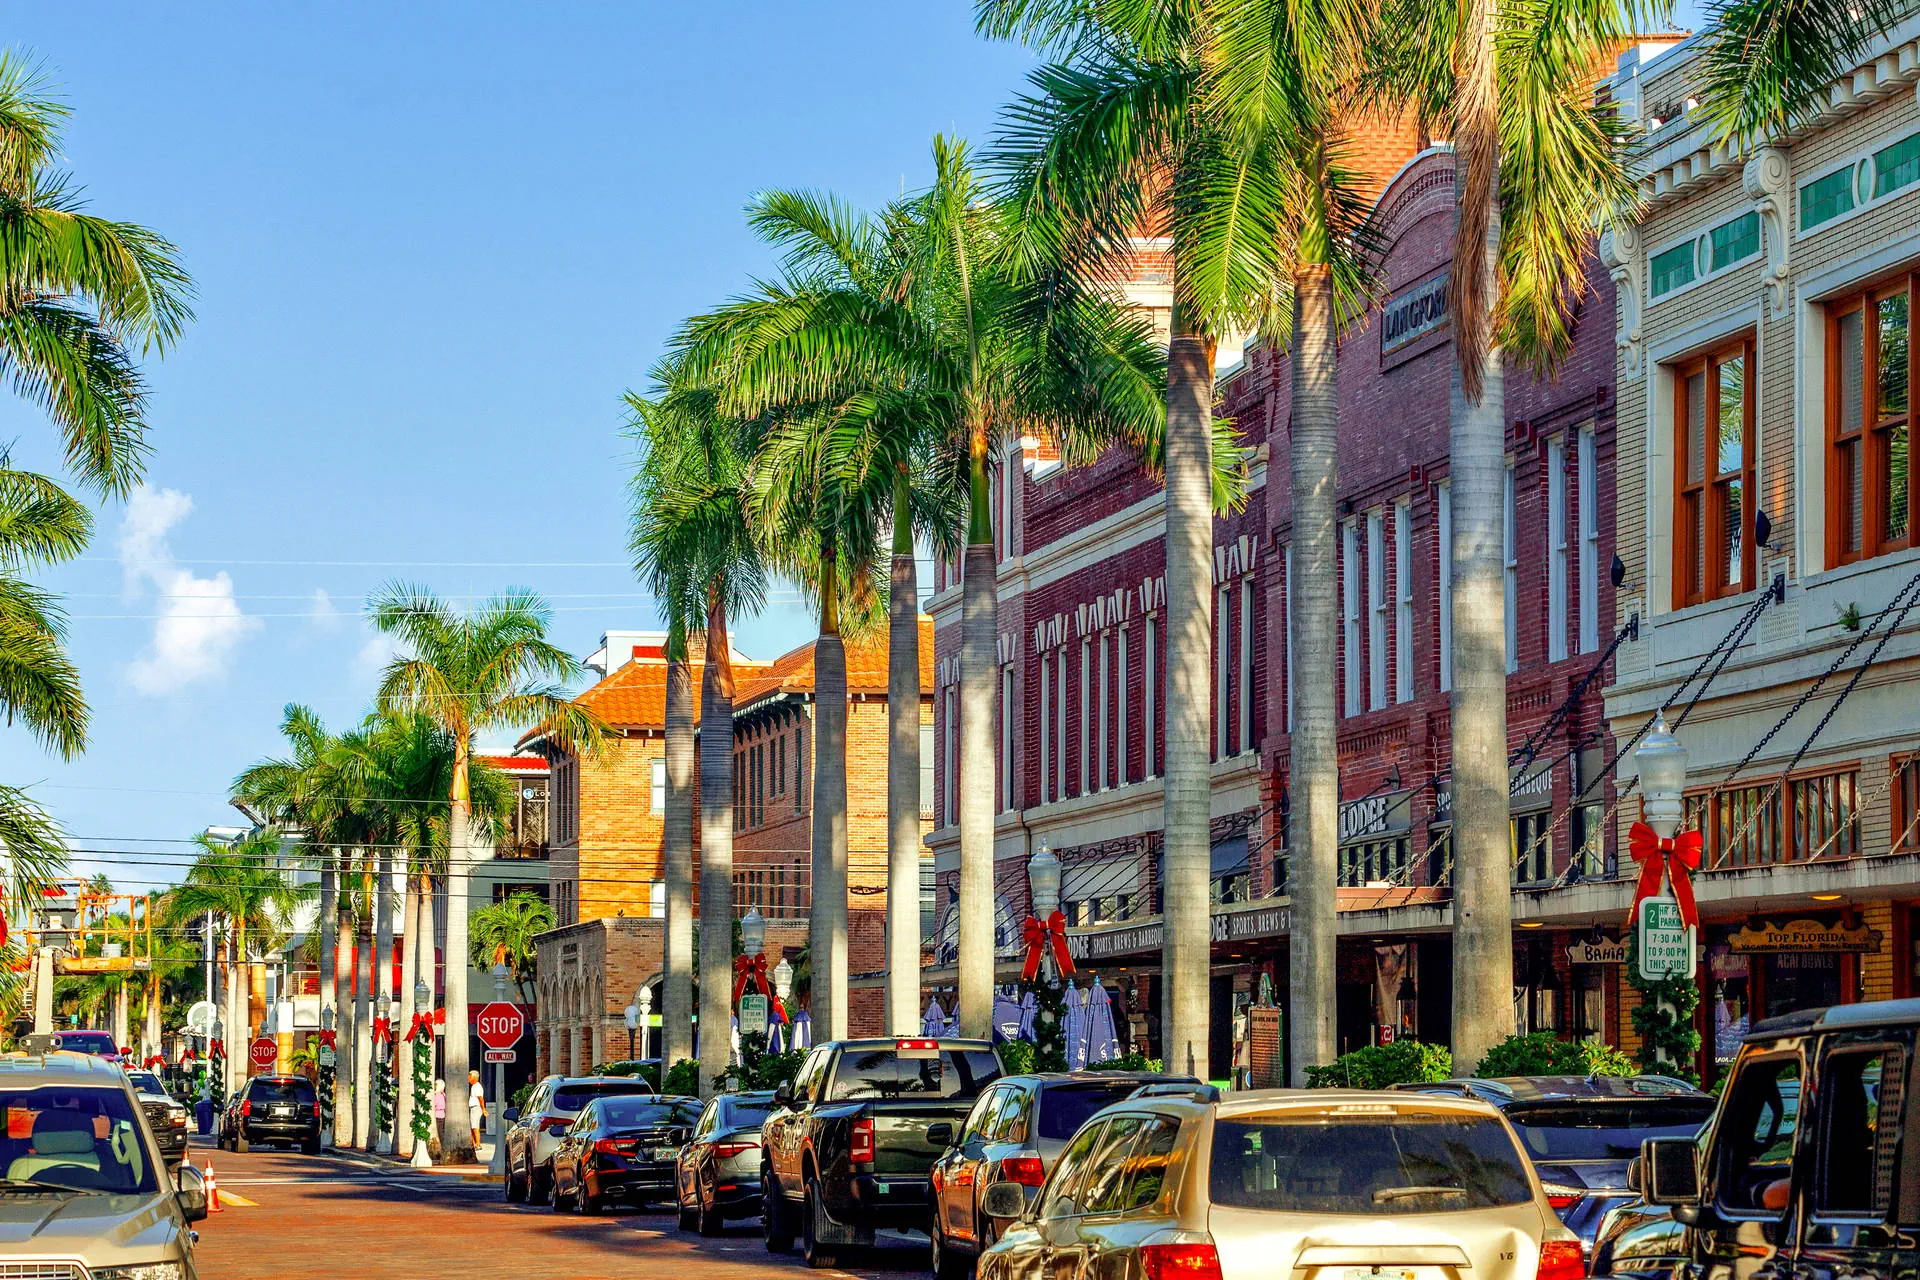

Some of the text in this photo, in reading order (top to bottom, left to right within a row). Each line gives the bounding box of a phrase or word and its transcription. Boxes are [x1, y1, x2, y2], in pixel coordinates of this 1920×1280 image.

[1340, 798, 1386, 838] LODGE
[1649, 909, 1656, 923] 2
[1233, 915, 1256, 936] SPORTS,
[1258, 911, 1279, 932] BREWS
[1281, 911, 1286, 929] &
[1093, 936, 1113, 954] SPORTS,
[1114, 931, 1131, 950] BREWS
[1133, 932, 1137, 948] &
[1653, 934, 1682, 943] 7:30 AM
[1648, 947, 1687, 957] TO 9:00 PM
[1649, 960, 1686, 969] THIS SIDE
[480, 1017, 520, 1034] STOP
[252, 1046, 276, 1057] STOP
[1500, 1252, 1514, 1261] V6
